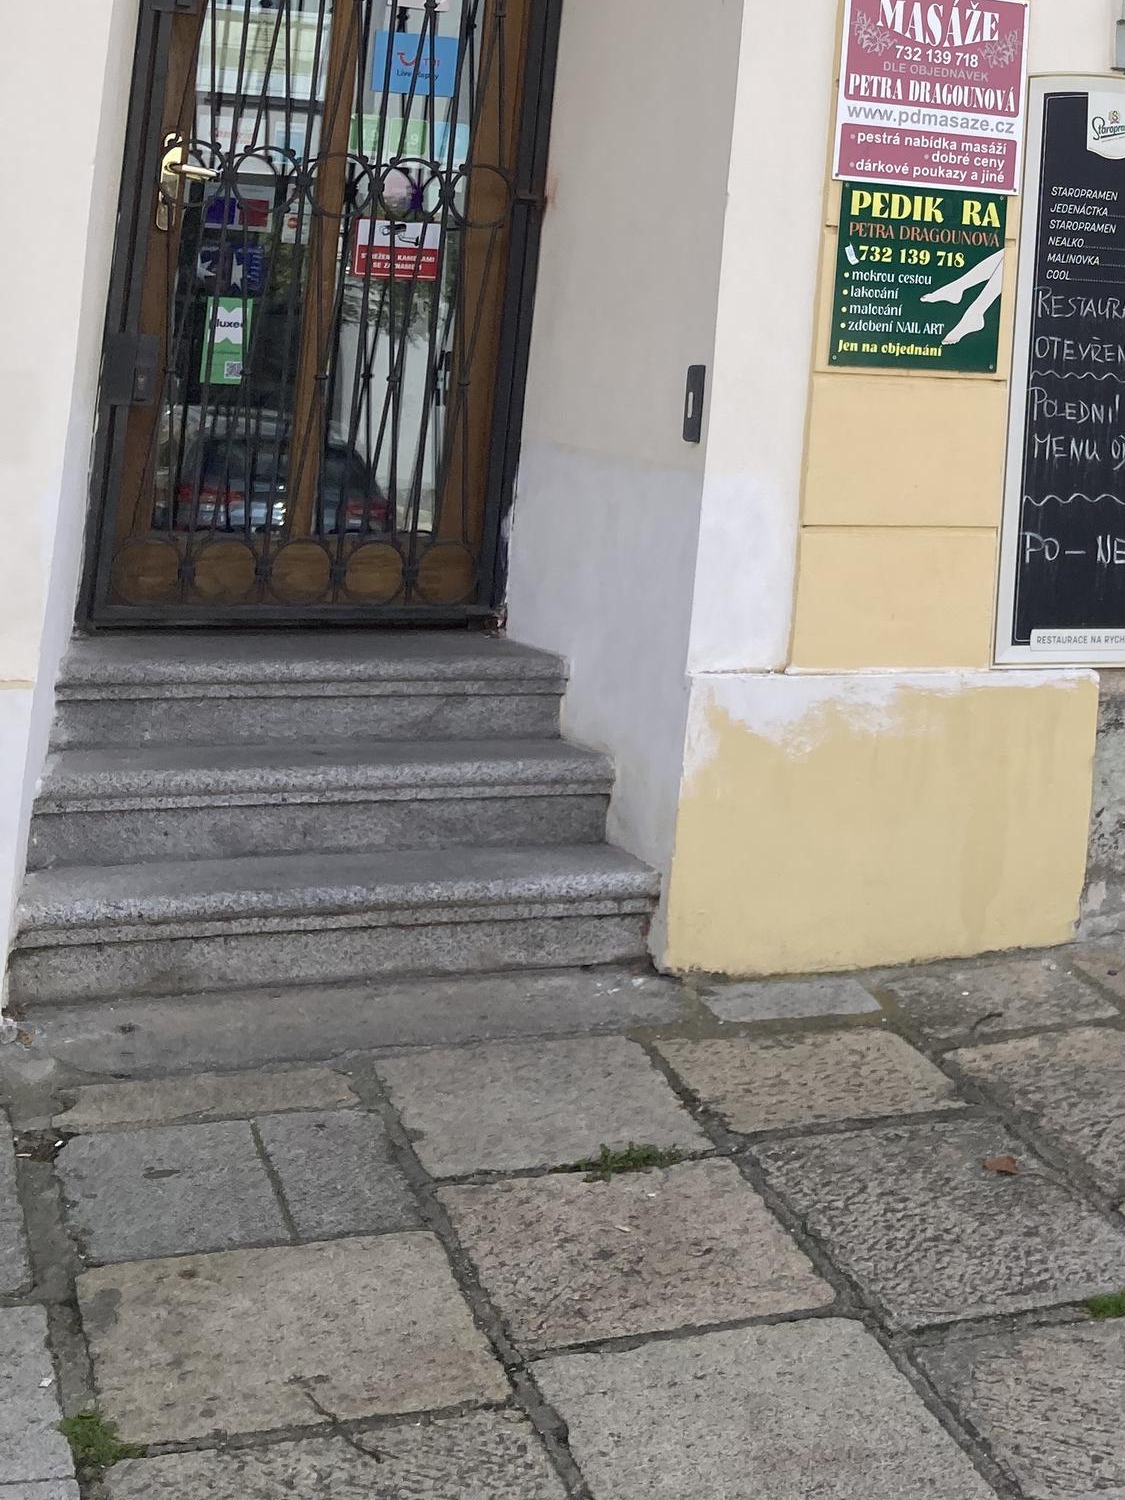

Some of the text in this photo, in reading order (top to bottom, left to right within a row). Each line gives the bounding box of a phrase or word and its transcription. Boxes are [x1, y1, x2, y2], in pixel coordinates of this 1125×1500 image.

[895, 45, 979, 68] 732 139 718
[883, 61, 989, 82] DLE OBJEDNÁVEK
[848, 73, 1015, 113] PETRA DRAGOUNOVÁ
[847, 105, 1015, 135] www.pdmasaze.cz
[857, 131, 1007, 155] pestrá nabídka masáží
[931, 151, 1005, 171] dobré ceny
[855, 159, 1005, 184] dárkové poukazy a jiné
[1051, 186, 1118, 201] STAROPRAMEN
[850, 190, 1001, 228] PEDIKRA
[1050, 203, 1108, 217] JEDENÁCTKA
[850, 222, 1000, 248] PETRA DRAGOUNOVÁ
[1049, 219, 1117, 233] STAROPRAMEN
[1048, 236, 1084, 249] NEALKO
[858, 245, 965, 268] 732 139 718
[1047, 253, 1100, 266] MALINOVKA
[852, 269, 932, 285] mokrou cestou
[1046, 269, 1071, 281] COOL
[850, 286, 899, 299] lakování
[850, 303, 902, 316] malování
[848, 320, 944, 335] zdobení NAIL ART
[862, 343, 878, 353] na
[881, 340, 943, 357] objednání
[1033, 433, 1101, 462] MENU
[1021, 532, 1060, 564] PO
[1036, 635, 1088, 645] RESTAURACE
[1090, 635, 1102, 644] NA
